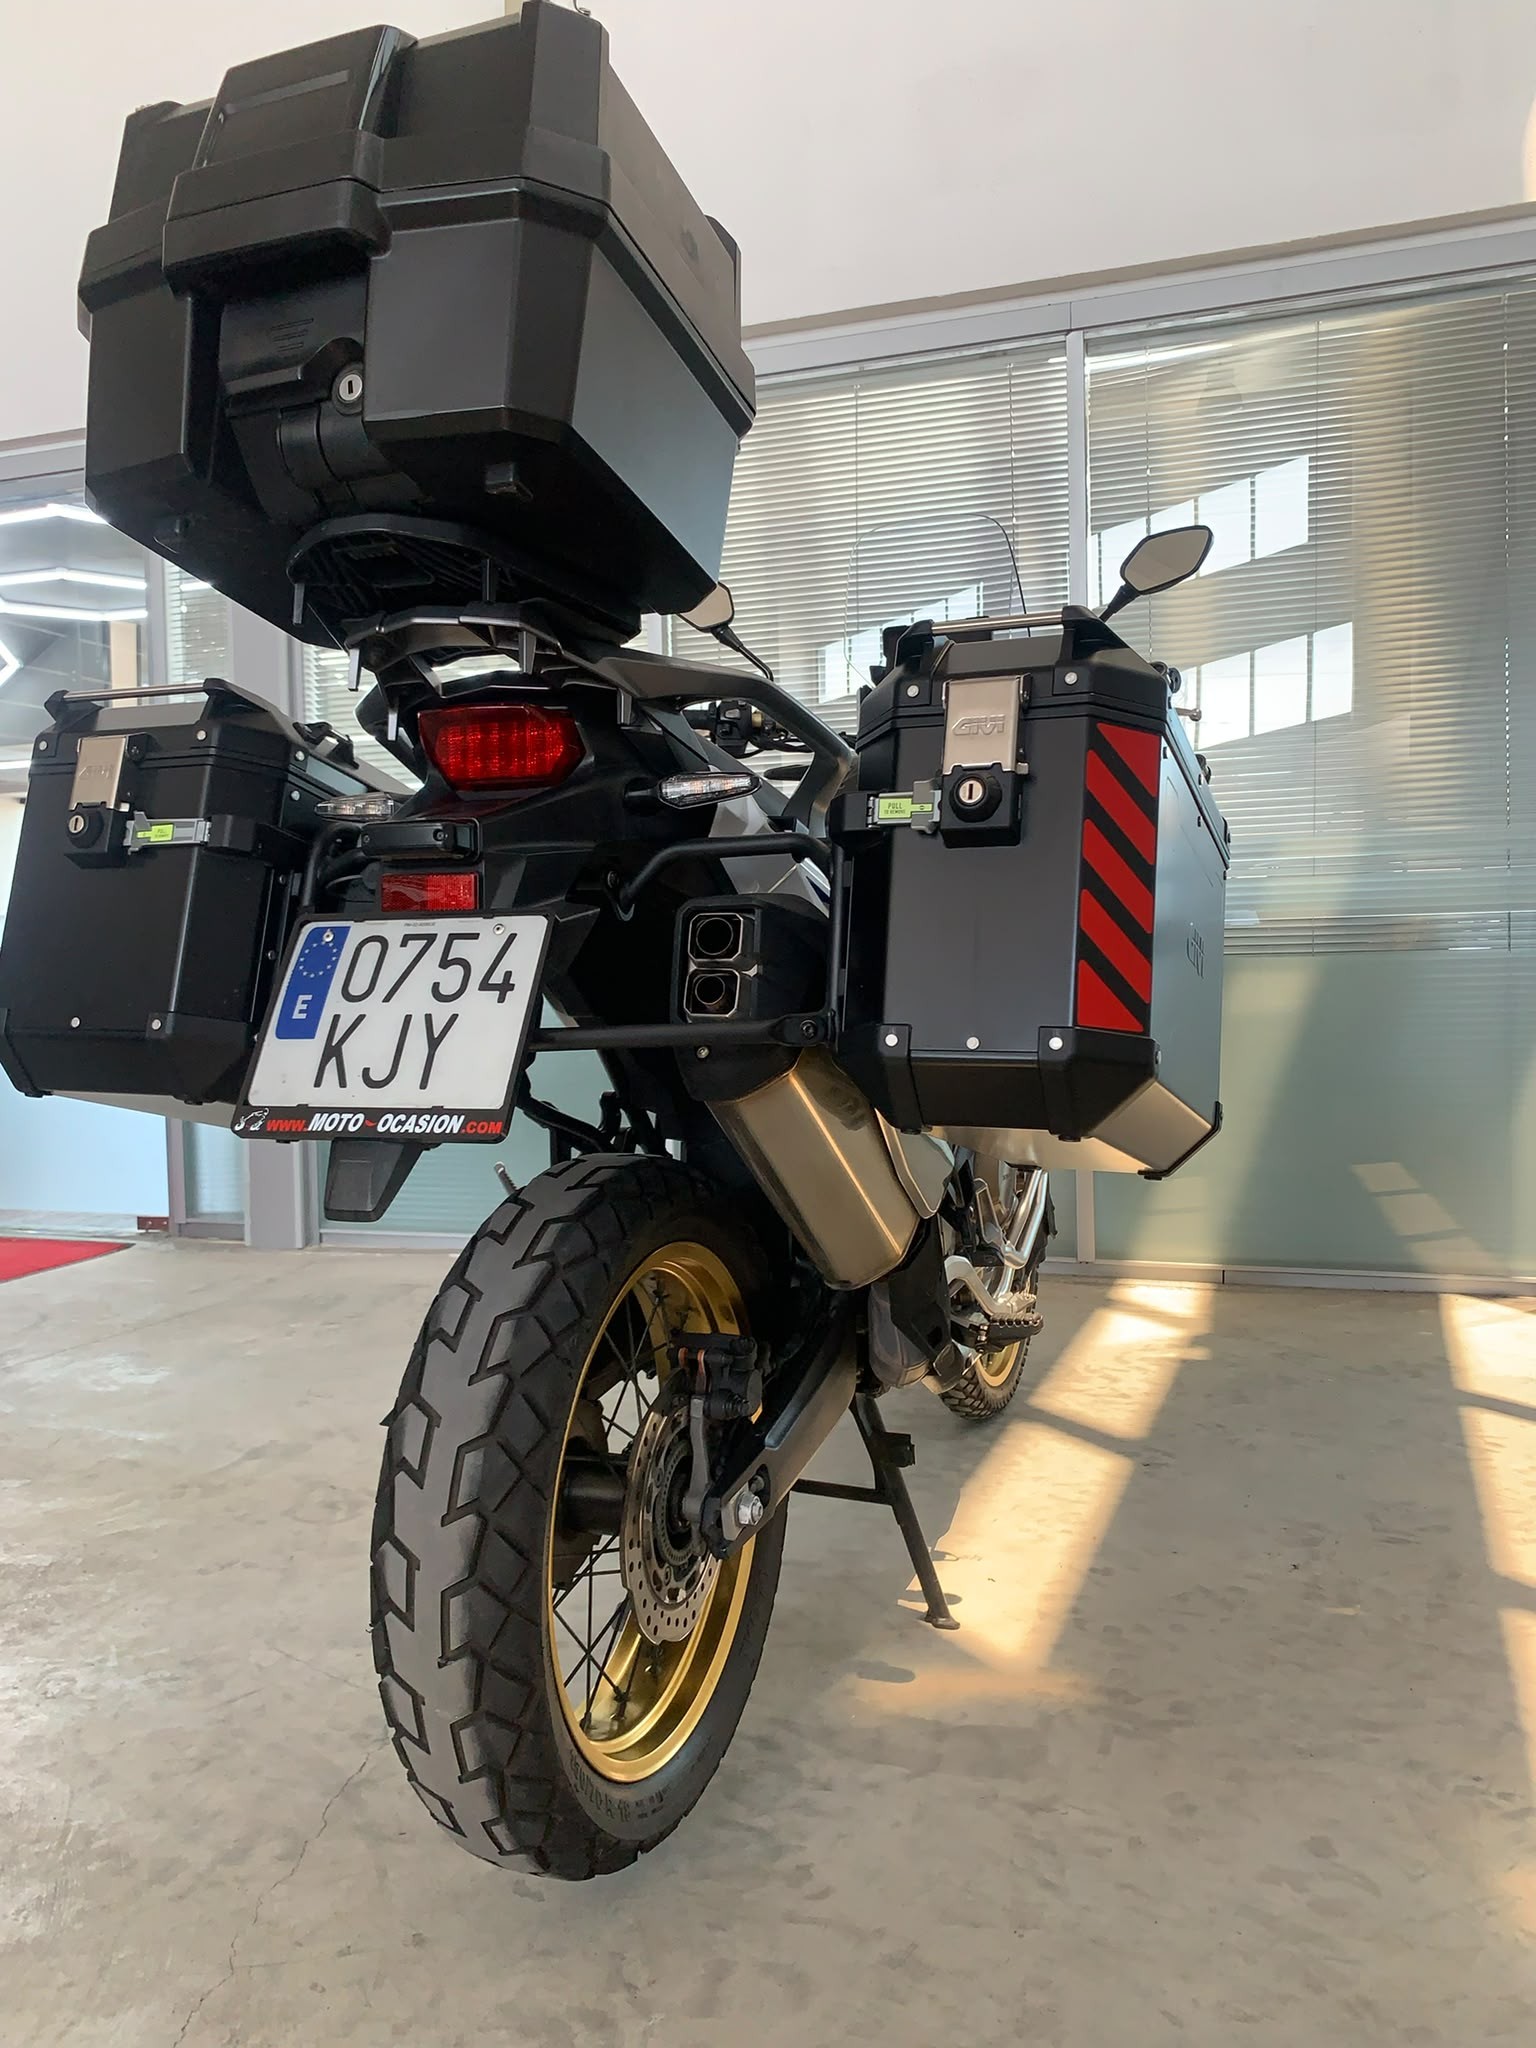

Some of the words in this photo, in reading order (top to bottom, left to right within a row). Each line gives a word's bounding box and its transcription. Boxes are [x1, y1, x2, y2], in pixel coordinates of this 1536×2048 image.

[952, 714, 1005, 736] GIVI
[341, 932, 517, 1004] 0754
[292, 994, 313, 1019] E
[313, 1013, 459, 1090] KJY
